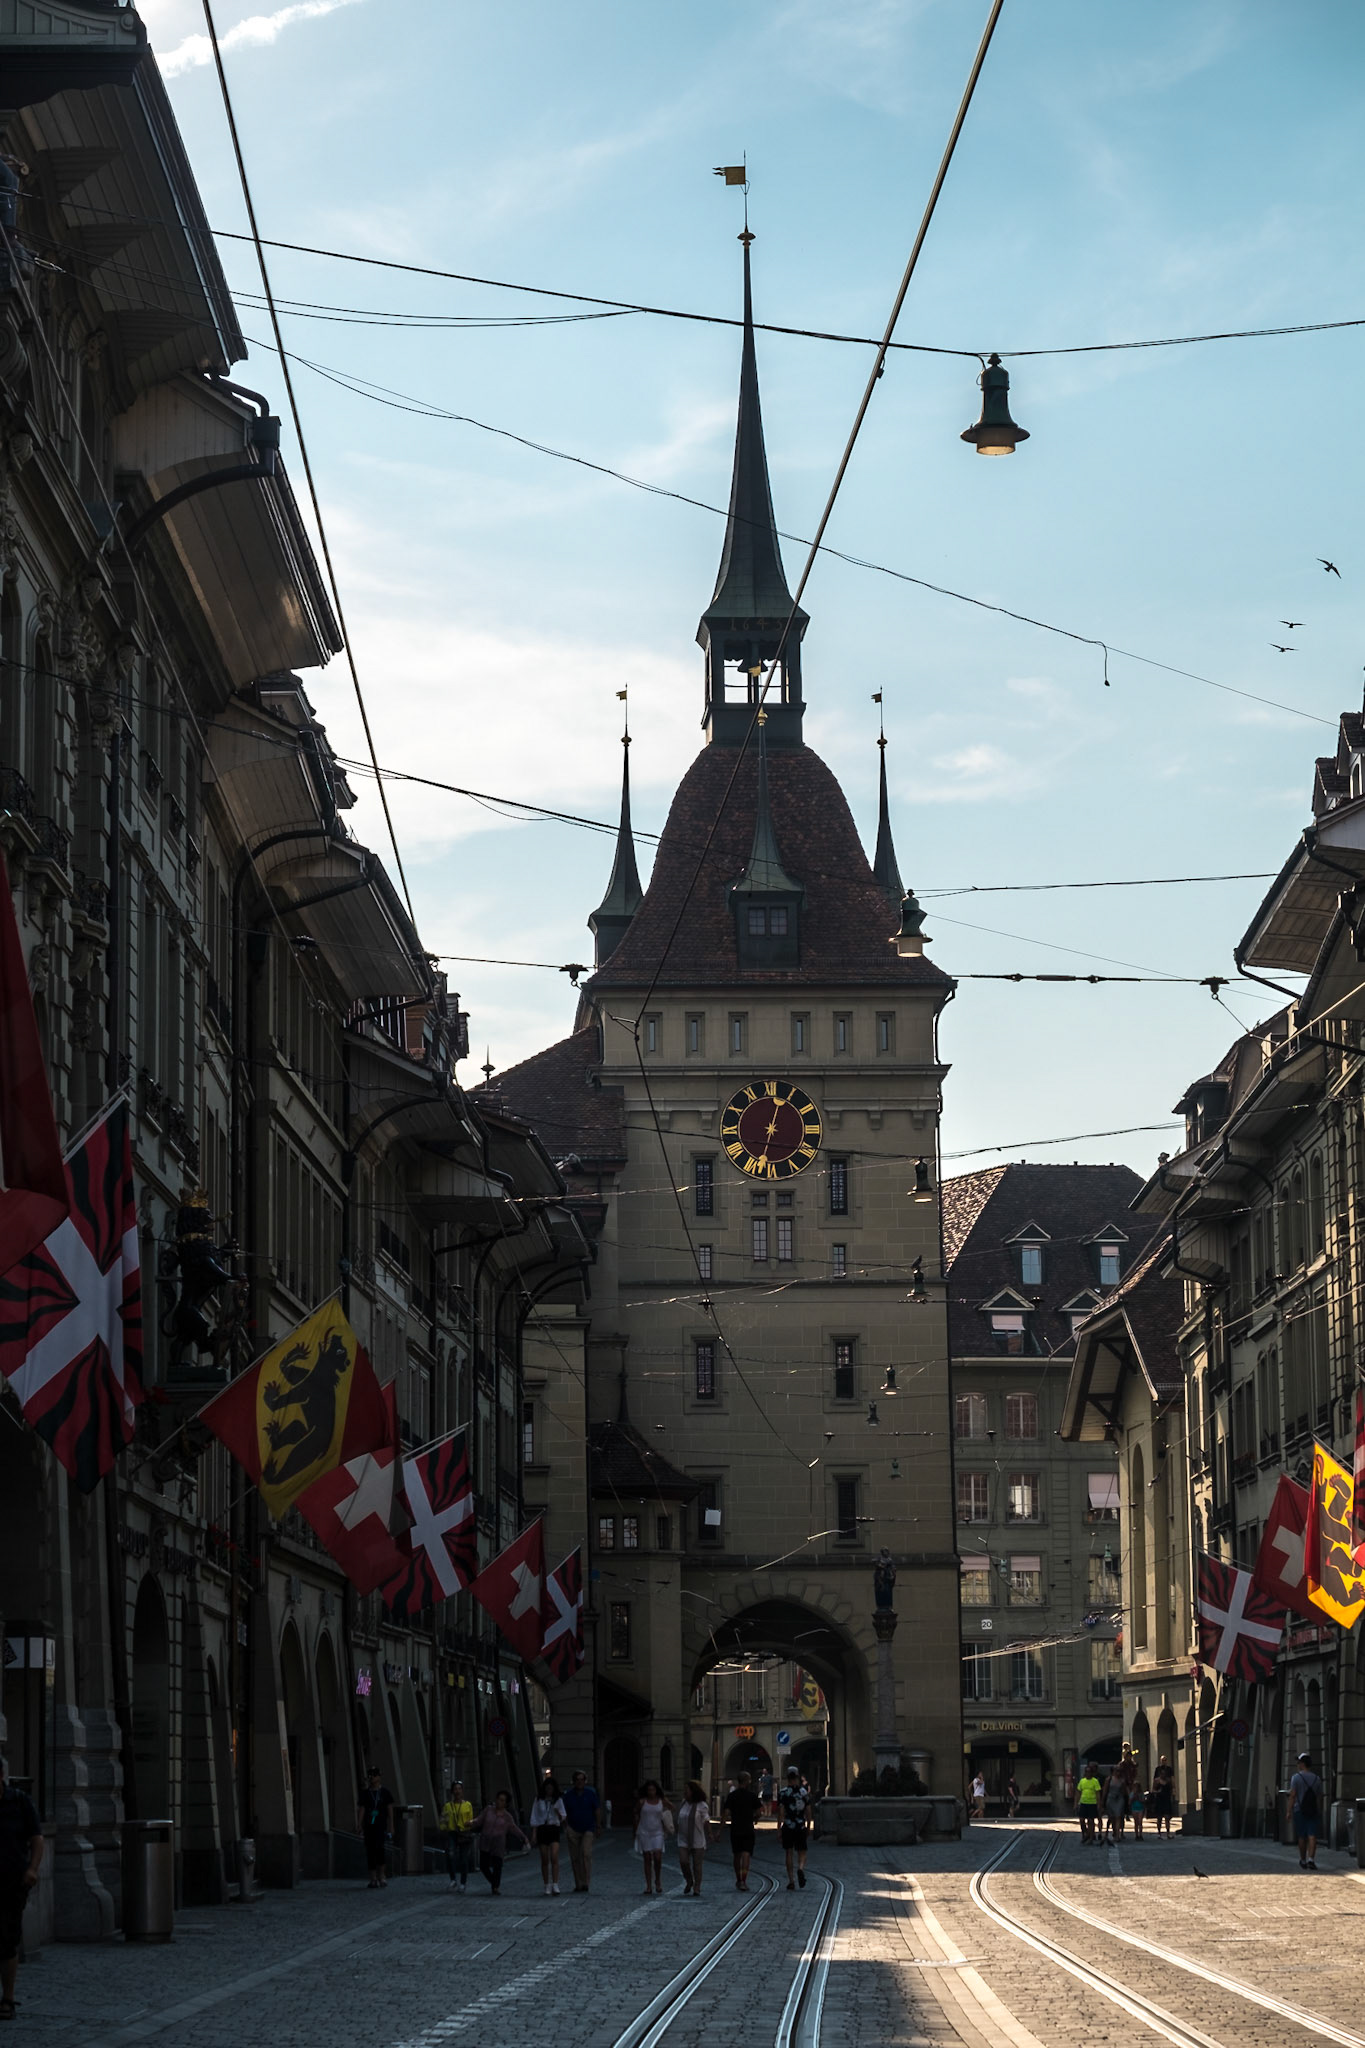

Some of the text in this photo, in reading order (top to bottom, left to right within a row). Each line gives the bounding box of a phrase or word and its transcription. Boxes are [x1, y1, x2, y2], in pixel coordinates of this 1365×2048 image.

[743, 1086, 758, 1103] XI
[764, 1081, 777, 1096] XII
[787, 1088, 797, 1101] I
[728, 1104, 743, 1116] X
[800, 1103, 814, 1115] II
[722, 1125, 737, 1135] IX
[805, 1125, 820, 1135] III
[727, 1142, 744, 1159] VIII
[743, 1157, 758, 1174] VII
[767, 1164, 778, 1178] VI
[788, 1159, 800, 1173] V
[735, 1725, 755, 1740] coop
